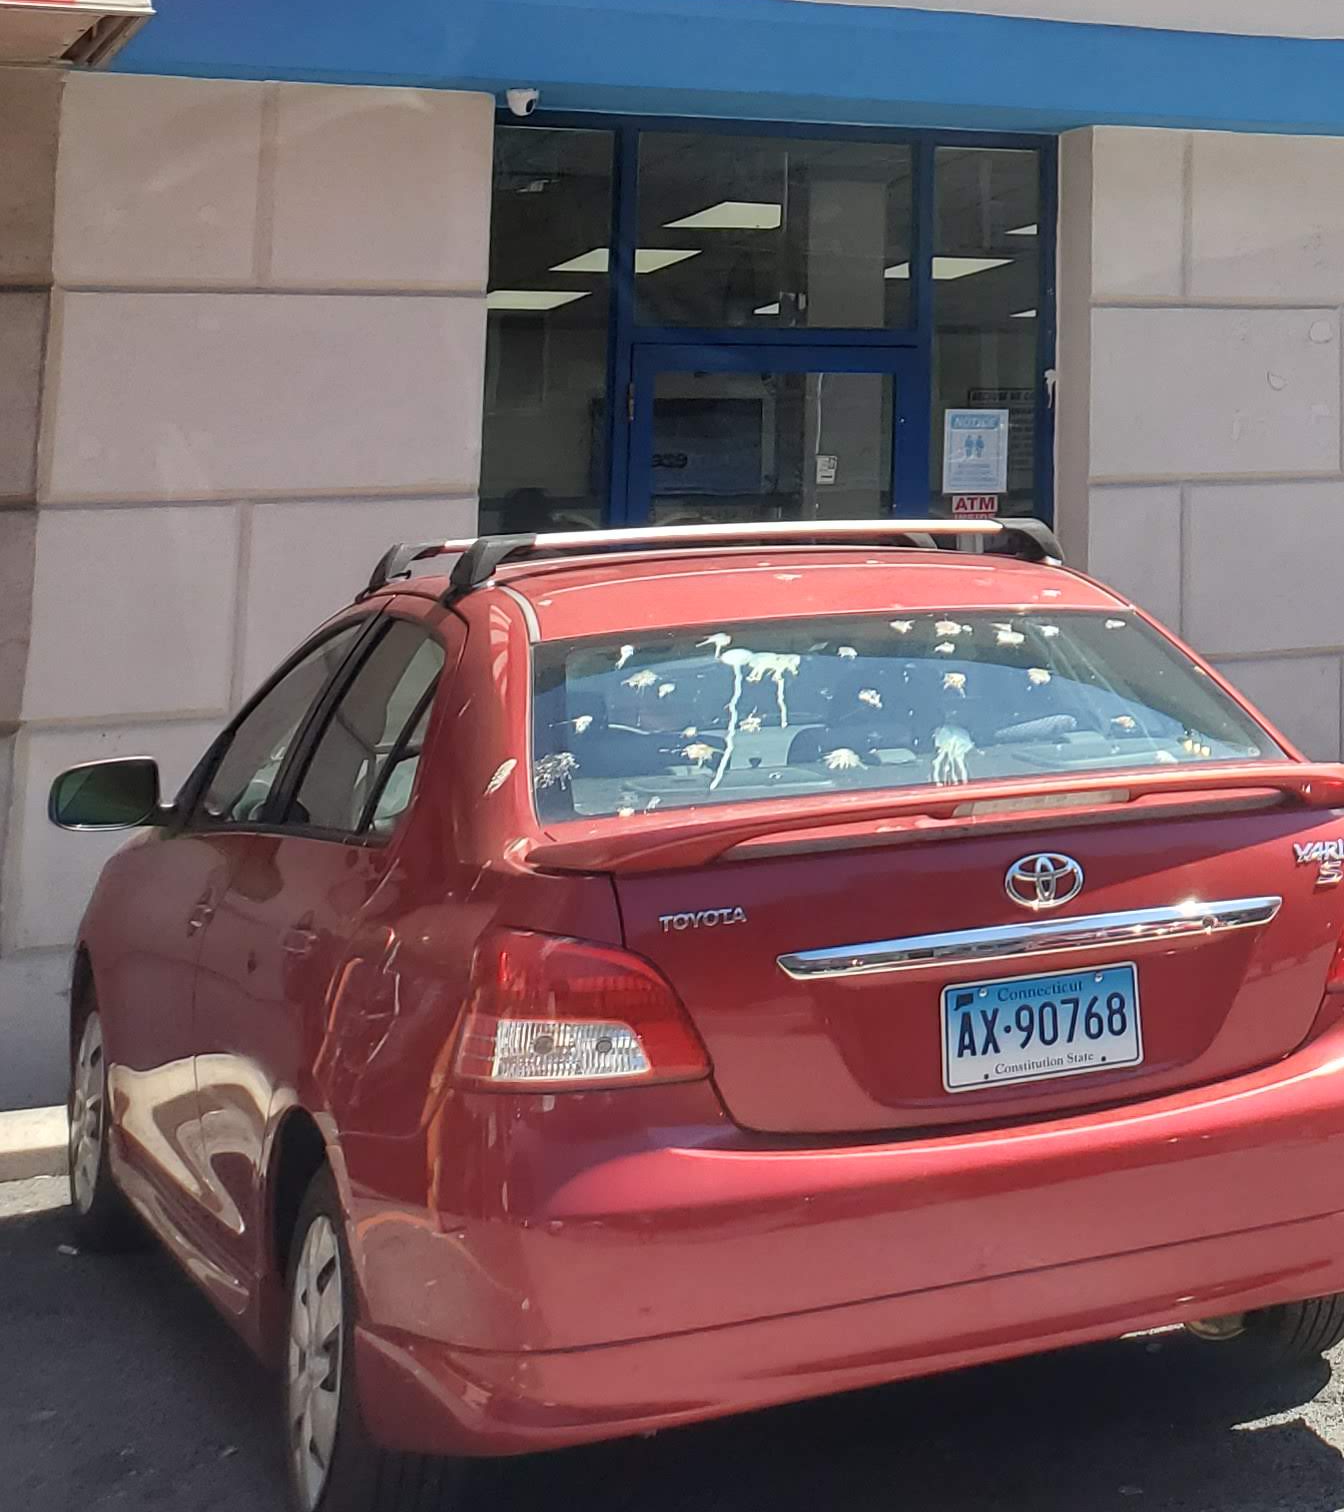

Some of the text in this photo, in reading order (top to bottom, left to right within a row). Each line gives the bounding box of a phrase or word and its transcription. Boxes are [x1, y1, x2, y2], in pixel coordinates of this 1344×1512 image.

[955, 497, 994, 510] ATM
[659, 907, 747, 932] TOYOTA
[998, 980, 1083, 1001] Connecticut
[995, 1053, 1094, 1074] Constitution State
